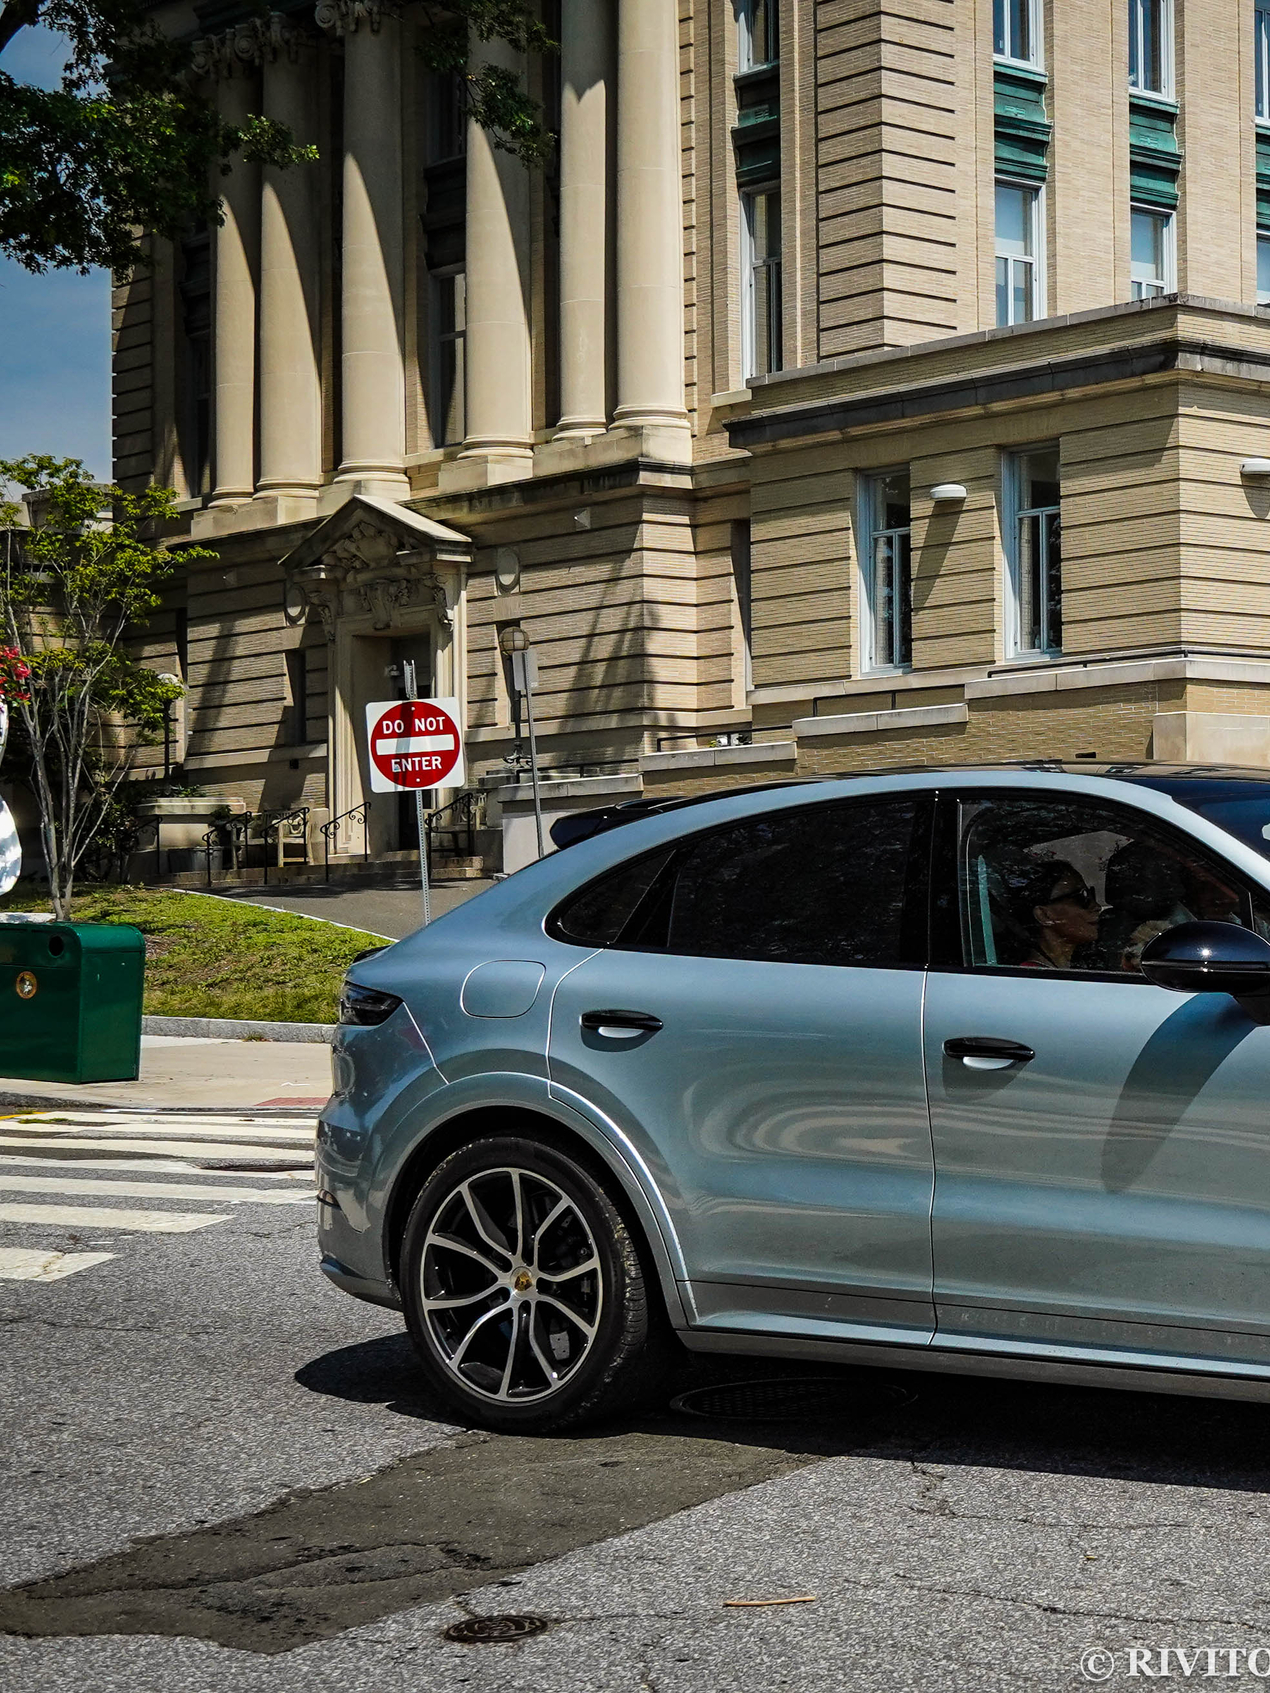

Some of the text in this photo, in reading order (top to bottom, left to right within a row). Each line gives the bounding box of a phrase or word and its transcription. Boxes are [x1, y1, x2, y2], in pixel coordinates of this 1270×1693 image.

[382, 717, 445, 734] DO NOT
[391, 756, 442, 772] ENTER
